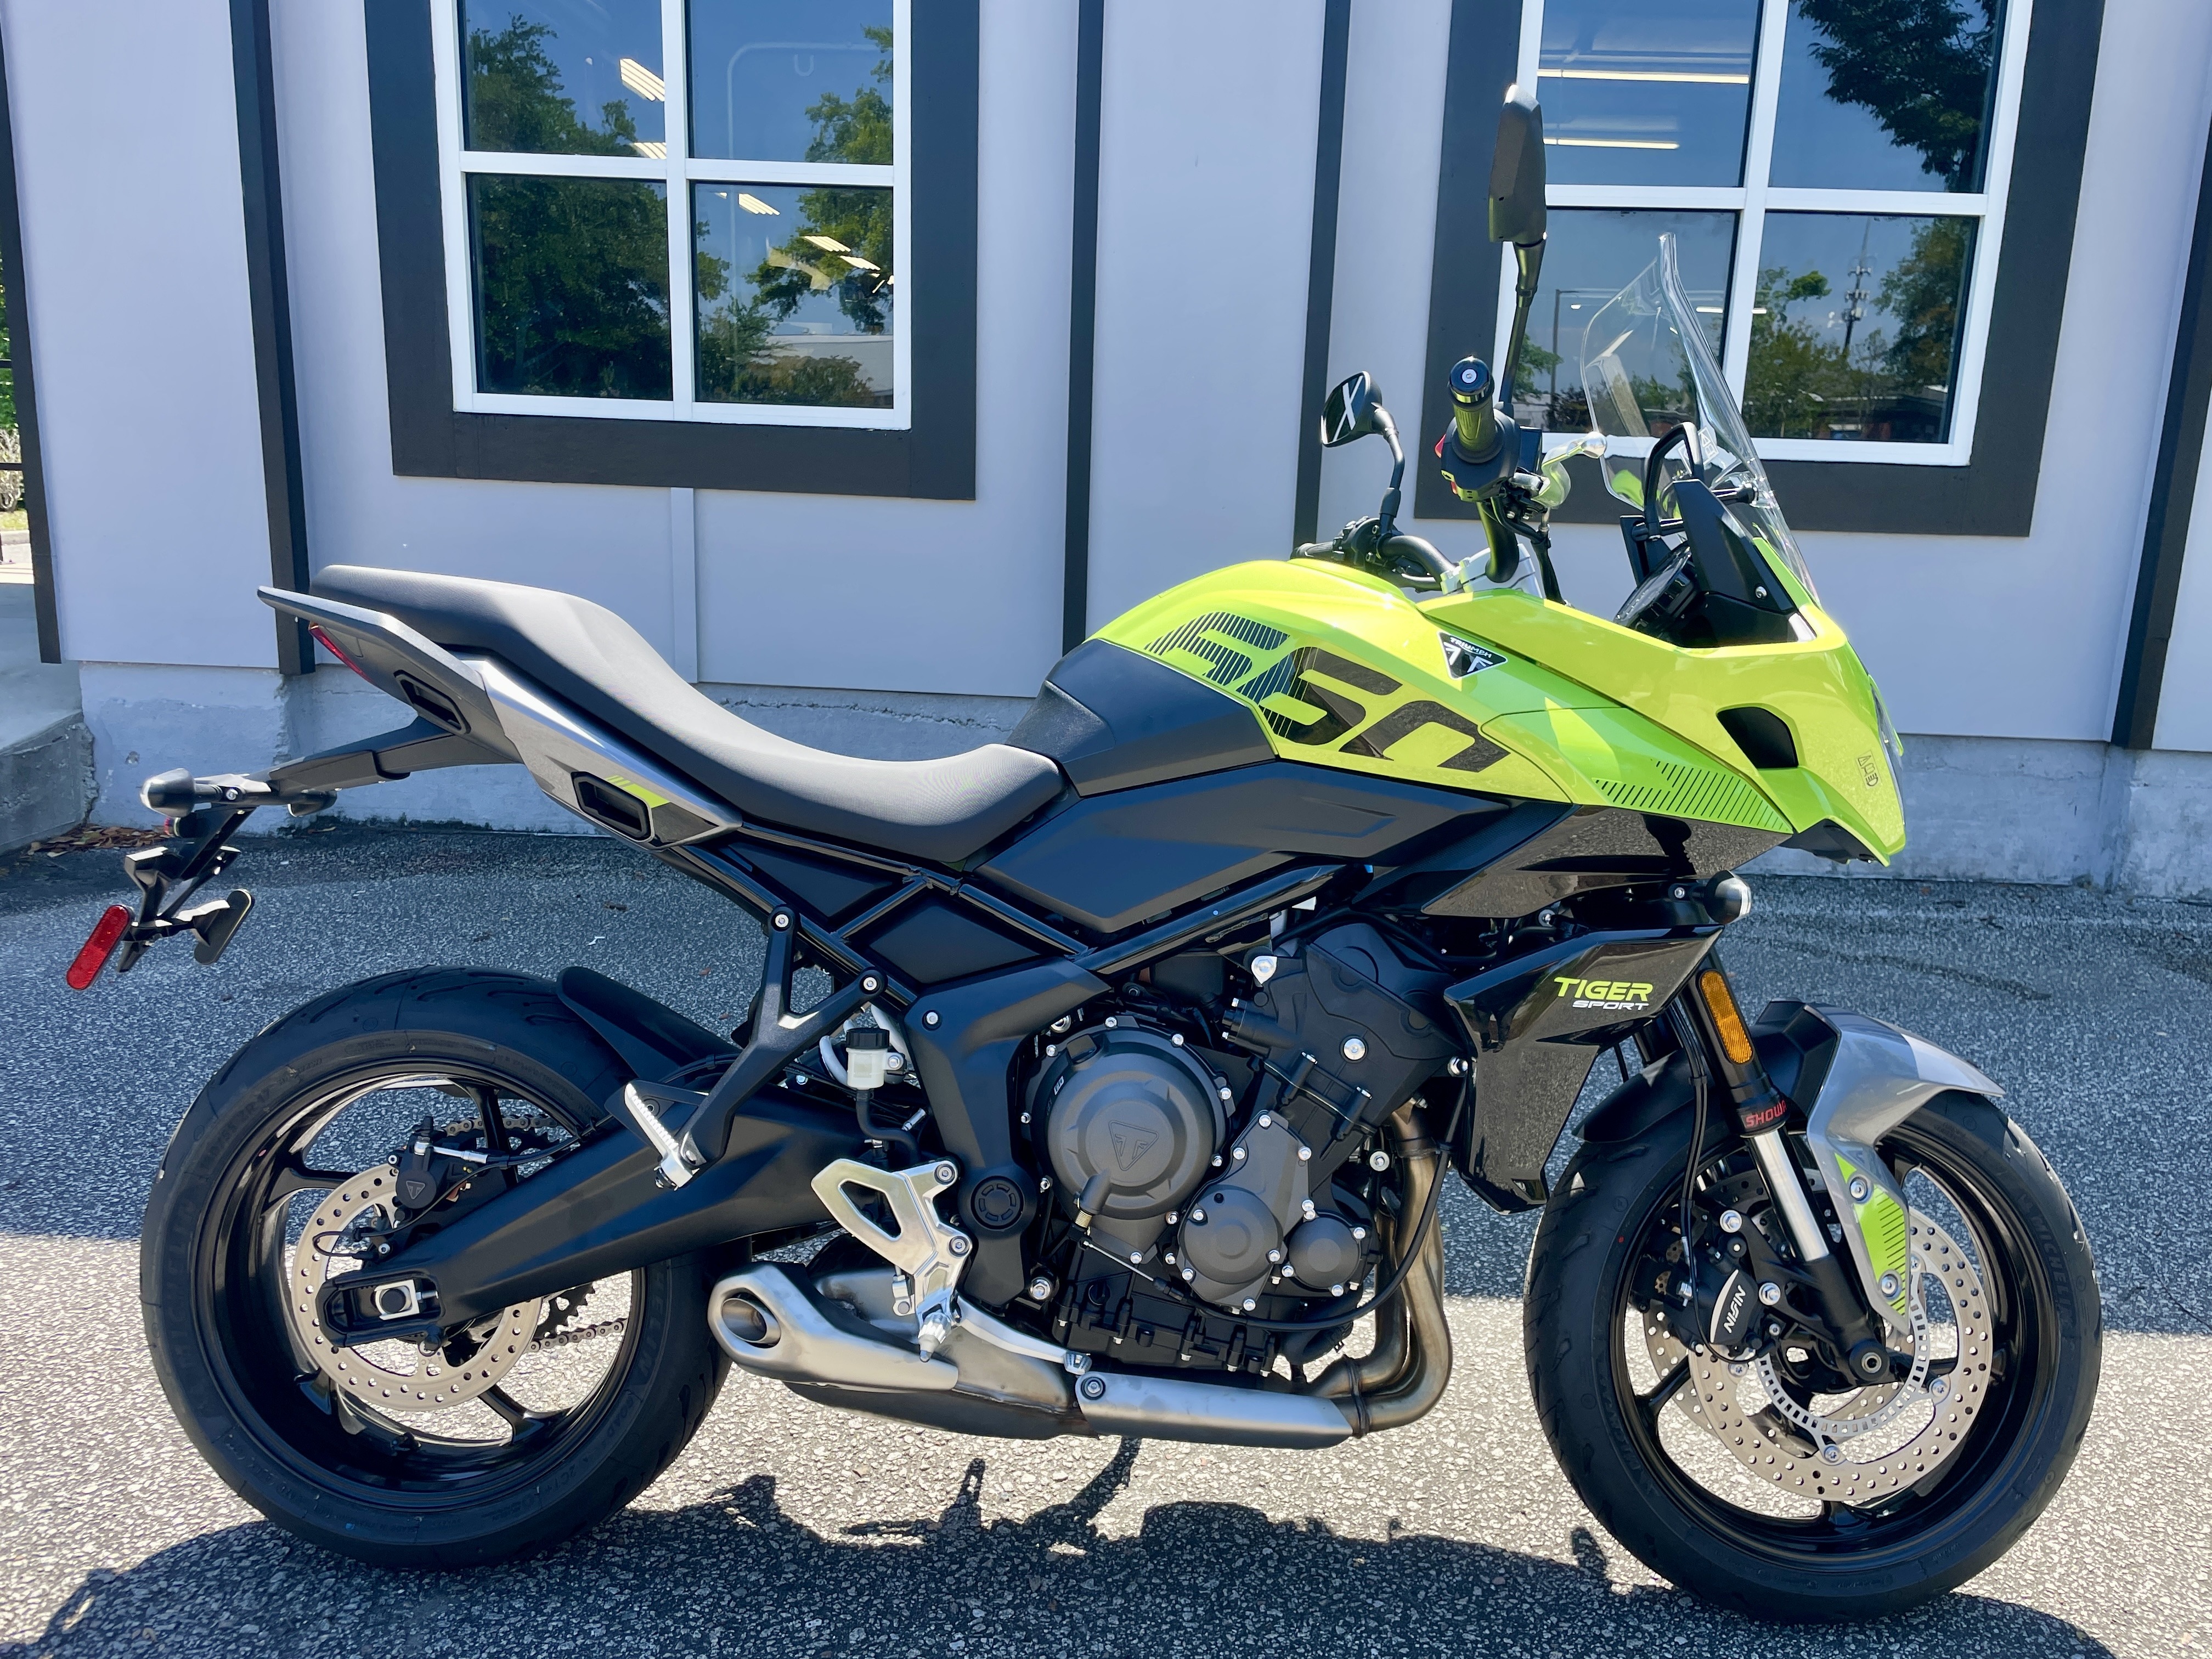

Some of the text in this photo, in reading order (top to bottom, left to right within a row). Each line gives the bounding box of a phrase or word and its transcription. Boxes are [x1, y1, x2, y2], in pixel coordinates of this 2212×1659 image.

[1450, 637, 1492, 658] TRIUMPH
[1554, 977, 1654, 1002] TIGER
[1572, 1000, 1649, 1011] SPORT
[1746, 1099, 1787, 1128] SHOWA
